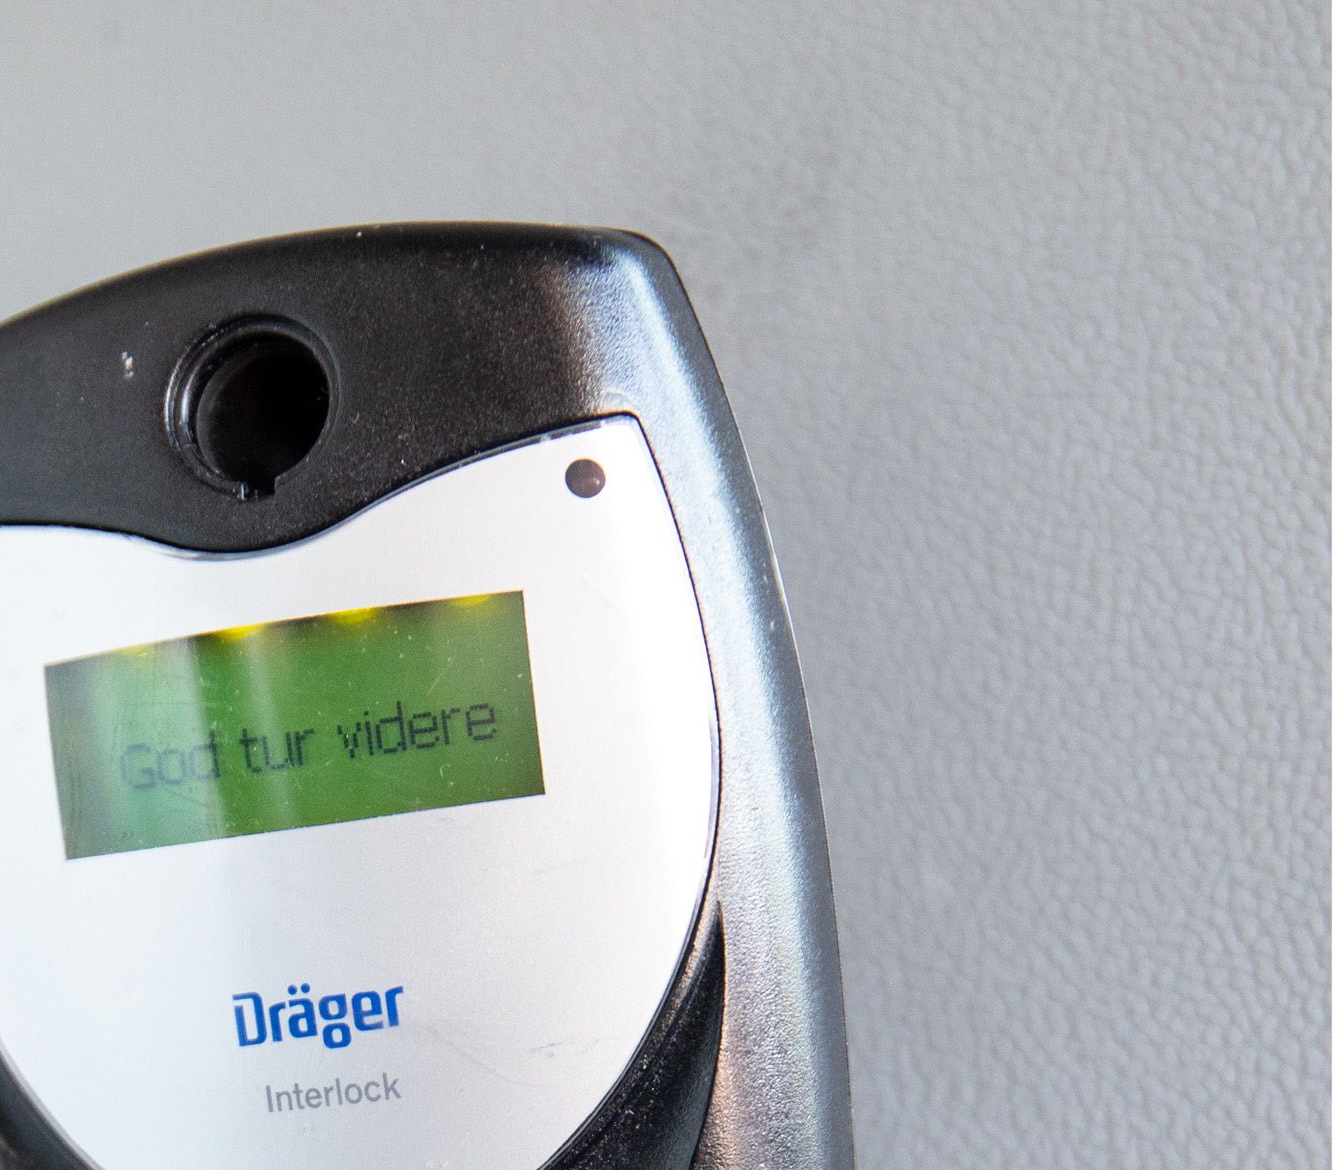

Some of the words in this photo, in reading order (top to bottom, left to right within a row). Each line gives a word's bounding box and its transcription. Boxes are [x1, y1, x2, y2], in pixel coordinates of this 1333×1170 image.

[119, 729, 221, 791] God
[239, 727, 314, 774] tur
[337, 701, 497, 759] videre
[232, 983, 405, 1049] Dräger
[265, 1072, 402, 1112] Interlock
